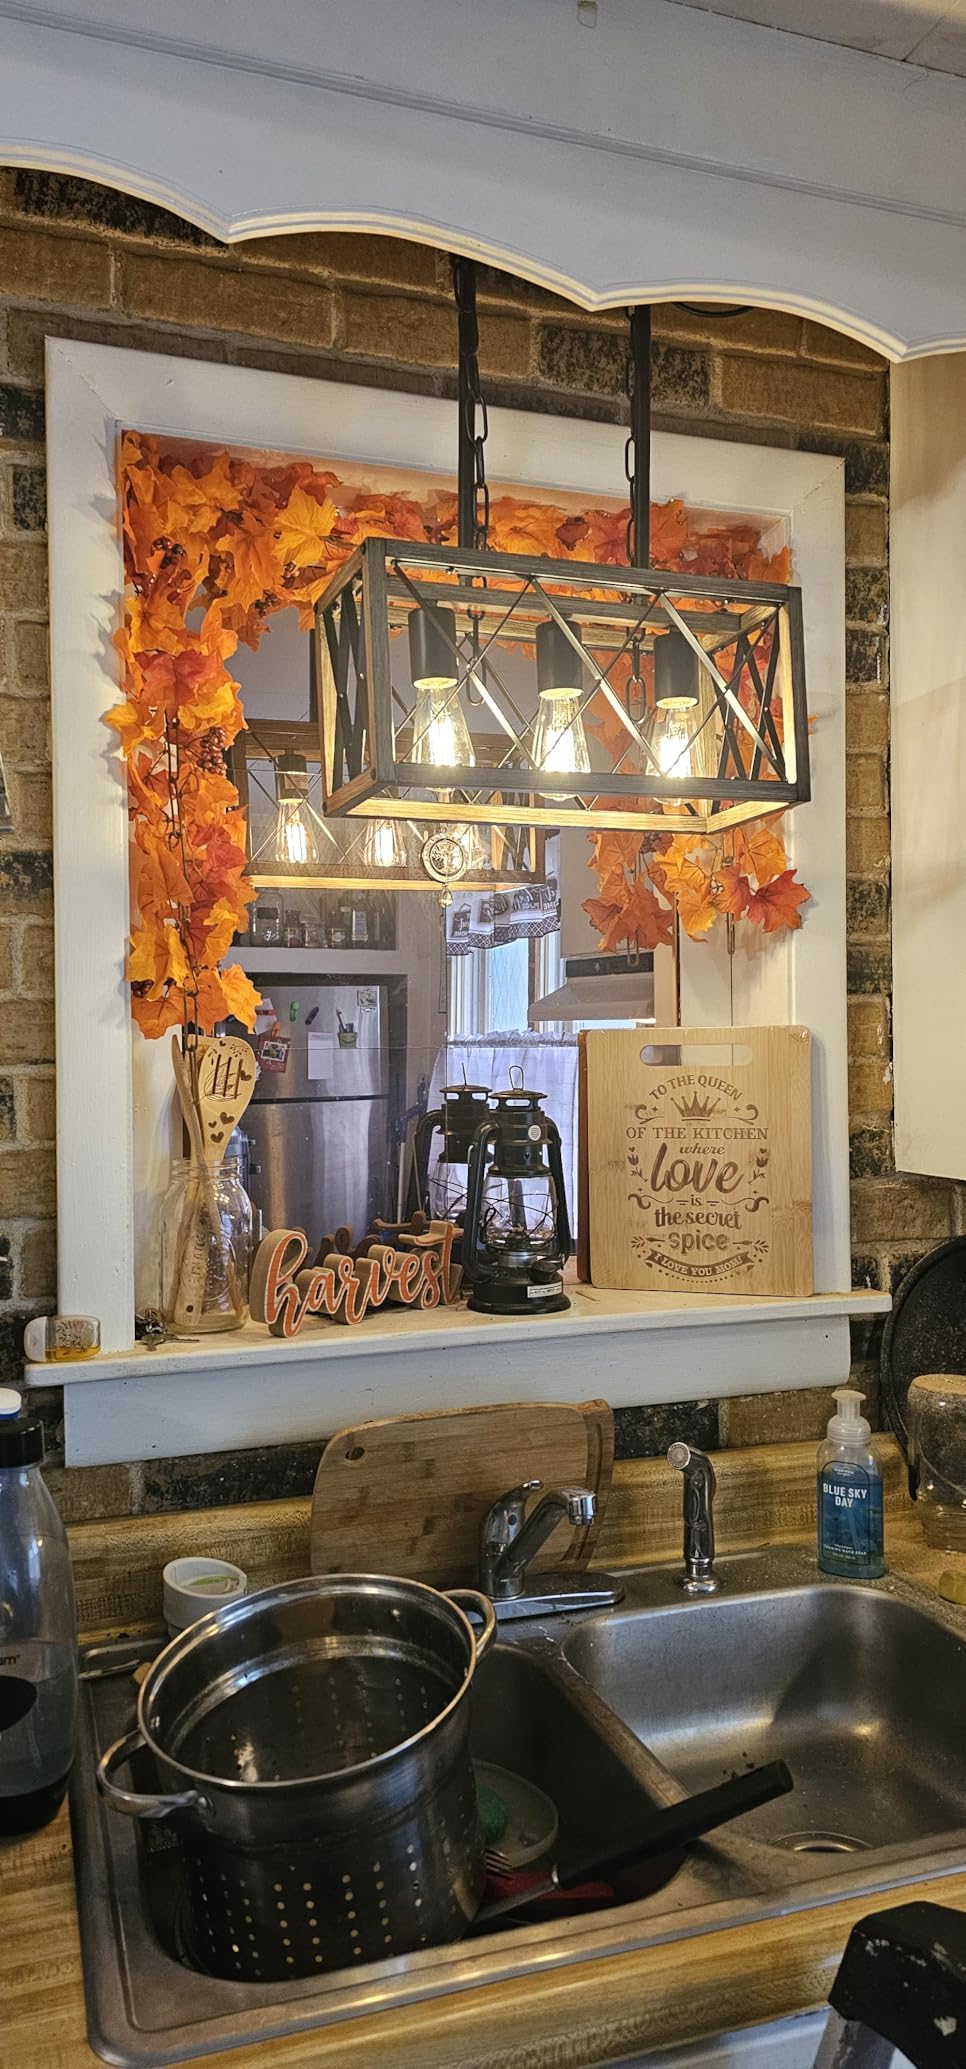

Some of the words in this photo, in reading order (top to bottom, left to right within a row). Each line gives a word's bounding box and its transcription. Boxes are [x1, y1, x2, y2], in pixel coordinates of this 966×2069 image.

[649, 1084, 668, 1101] TO
[667, 1074, 696, 1090] THE
[697, 1074, 744, 1101] QUEEN
[626, 1127, 647, 1139] OF
[652, 1127, 687, 1139] THE
[692, 1127, 769, 1140] KITCHEN
[679, 1143, 726, 1155] where
[650, 1142, 744, 1194] love
[690, 1194, 703, 1206] is
[655, 1206, 684, 1228] the
[685, 1208, 743, 1230] secret
[668, 1229, 728, 1255] spice
[661, 1257, 688, 1274] LOVE
[691, 1267, 713, 1276] YOU
[716, 1255, 743, 1274] MOM!
[258, 1221, 457, 1338] harvest
[823, 1483, 846, 1497] BLUE
[848, 1488, 868, 1499] SKY
[835, 1496, 854, 1508] DAY
